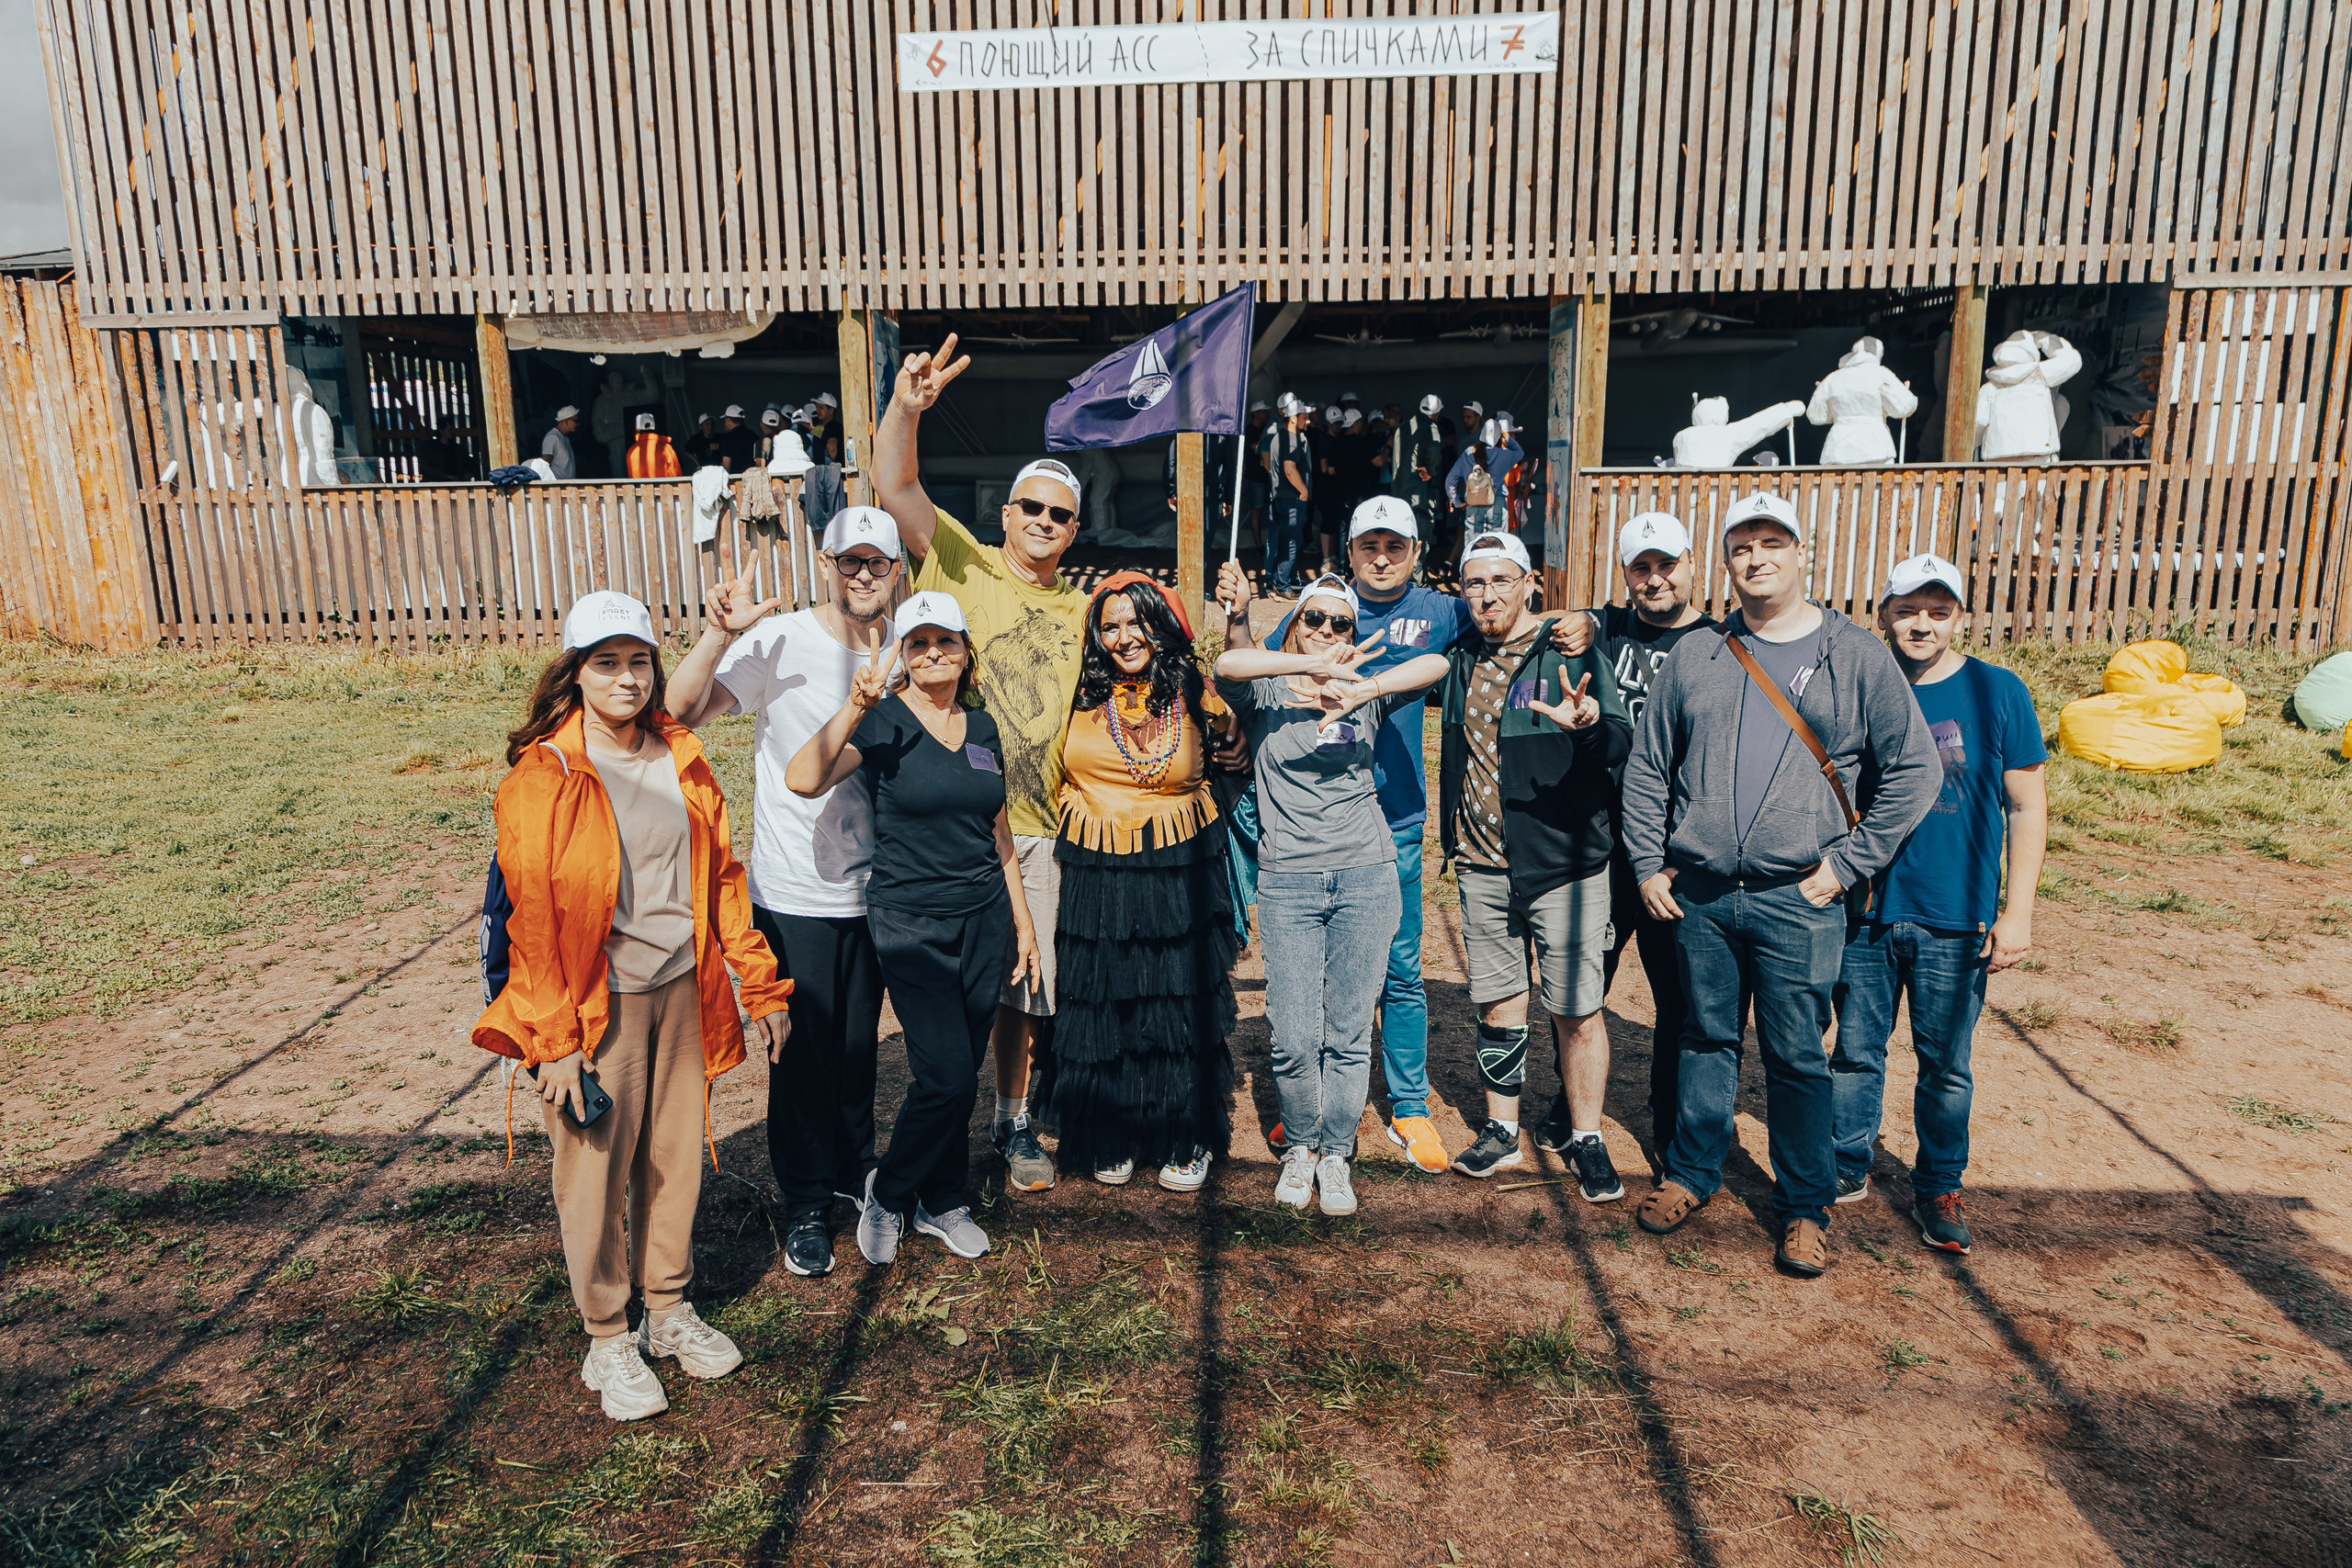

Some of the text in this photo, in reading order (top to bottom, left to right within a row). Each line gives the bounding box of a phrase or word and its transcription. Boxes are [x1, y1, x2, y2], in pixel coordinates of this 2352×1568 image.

[925, 32, 1159, 80] 6 ПОЮЩИЙ АСС
[1246, 24, 1526, 71] ЗА СПИЧКАМИ 7
